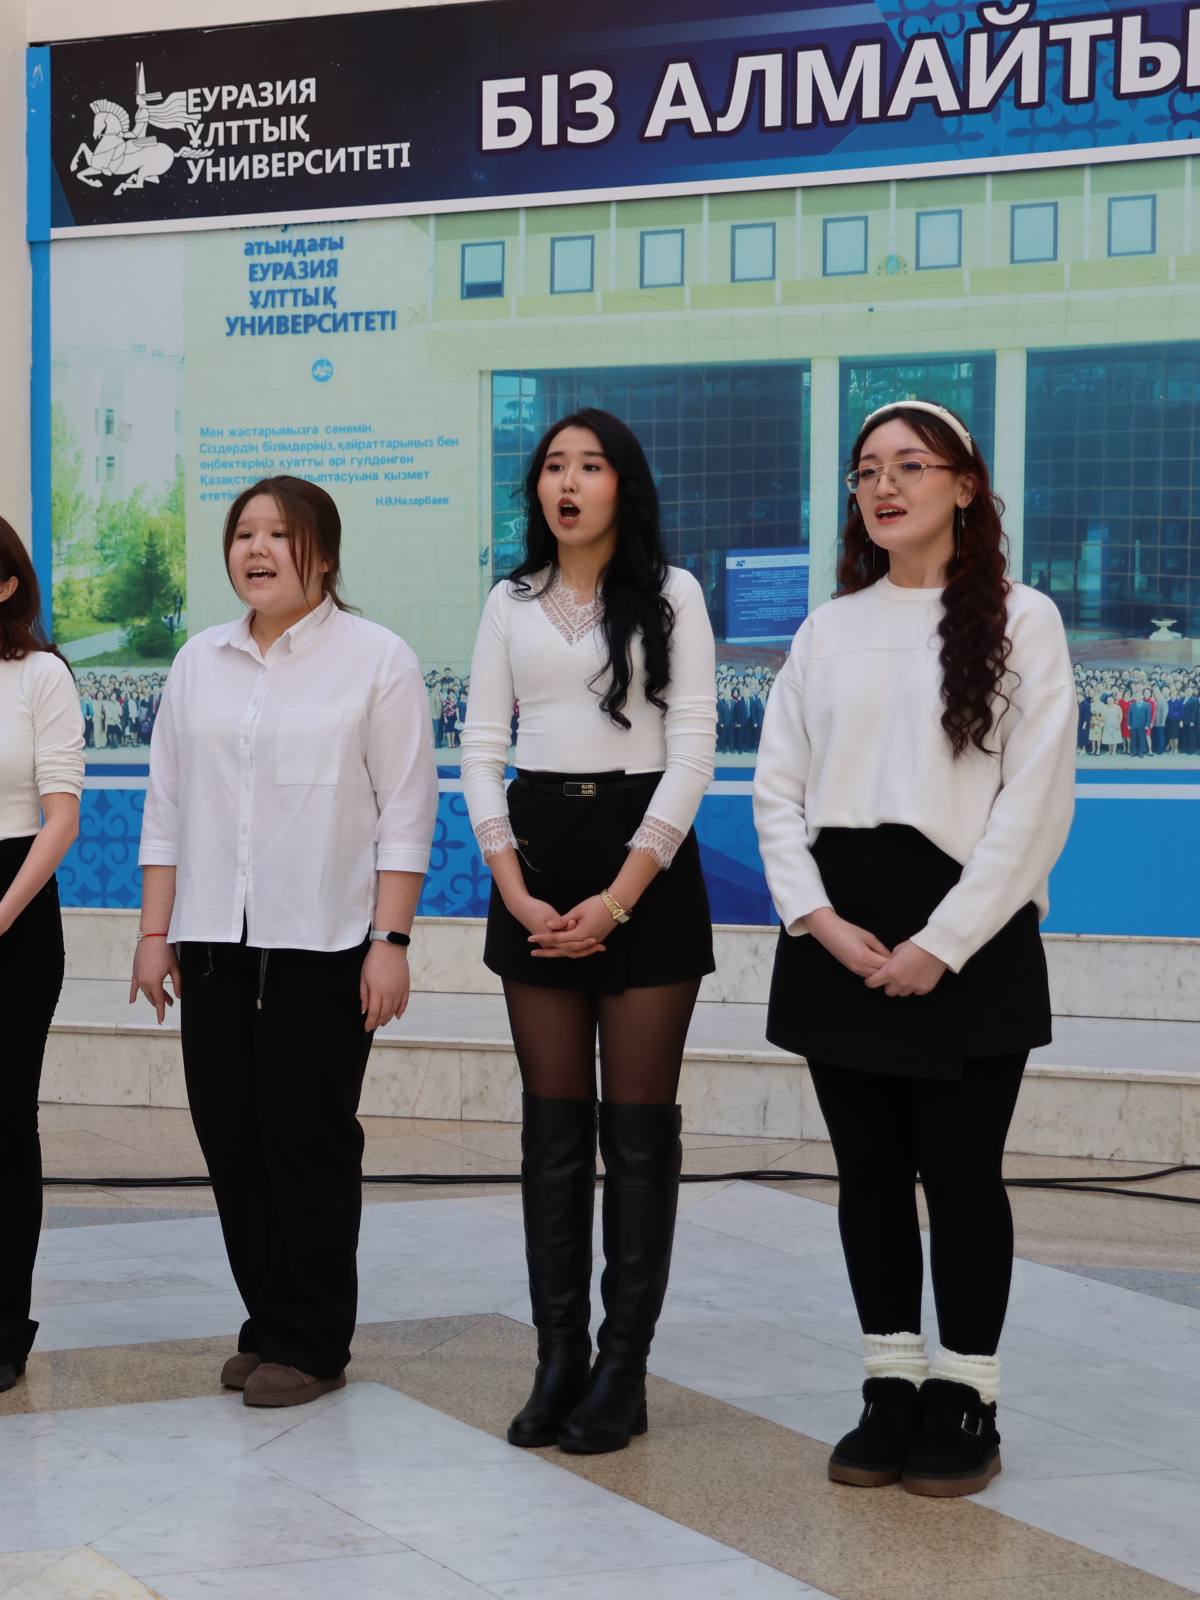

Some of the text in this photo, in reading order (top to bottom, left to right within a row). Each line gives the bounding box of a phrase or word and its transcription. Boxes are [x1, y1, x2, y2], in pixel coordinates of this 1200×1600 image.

[187, 77, 316, 113] ЕУРАЗИЯ
[481, 69, 615, 150] БІЗ
[186, 114, 310, 148] ҰЛТТЫҚ
[187, 142, 411, 185] УНИВЕРСИТЕТІ
[244, 236, 344, 257] атындағы
[248, 258, 339, 282] ЕУРАЗИЯ
[249, 286, 337, 309] ҰЛТТЫҚ
[225, 310, 397, 337] УНИВЕРСИТЕТІ
[199, 423, 375, 438] Мен жастарымызға сенемін.
[199, 442, 259, 455] Сіздердің
[437, 435, 459, 447] бен
[279, 457, 324, 470] қуатты
[328, 455, 346, 468] әрі
[384, 470, 430, 482] қызмет
